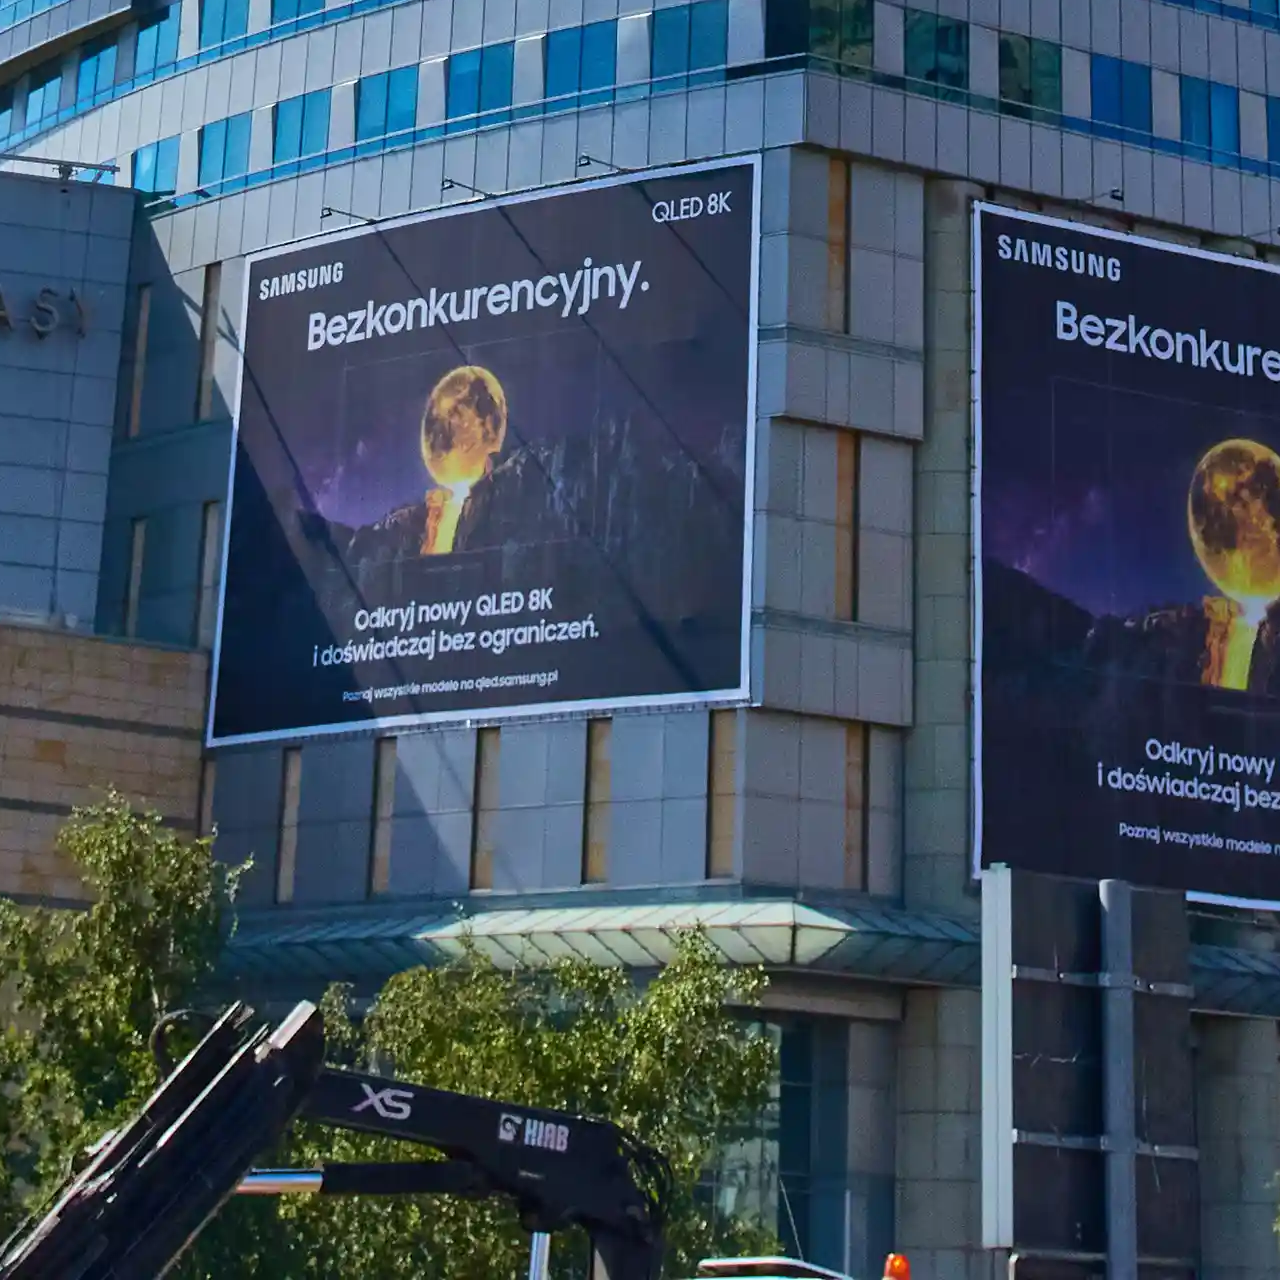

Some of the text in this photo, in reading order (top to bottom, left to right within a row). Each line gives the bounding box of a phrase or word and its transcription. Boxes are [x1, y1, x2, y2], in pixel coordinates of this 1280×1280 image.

[651, 191, 732, 224] QLED 8K
[997, 234, 1121, 283] SAMSUNG
[258, 261, 344, 301] SAMSUNG
[307, 256, 651, 351] Bezkonkurencyjny.
[354, 587, 554, 632] Odkryj nowy QLED 8K
[312, 613, 600, 667] i doświadczaj bez ograniczeń.
[460, 679, 474, 691] na
[1145, 738, 1214, 775] Odkryj
[1219, 752, 1276, 783] nowy
[1097, 762, 1103, 787] i
[1107, 767, 1241, 813] doświadczaj
[1119, 822, 1160, 845] Poznaj
[1163, 828, 1224, 850] wszystkie
[1225, 838, 1272, 855] modele
[349, 1082, 415, 1120] XS
[524, 1117, 570, 1154] HIAB
